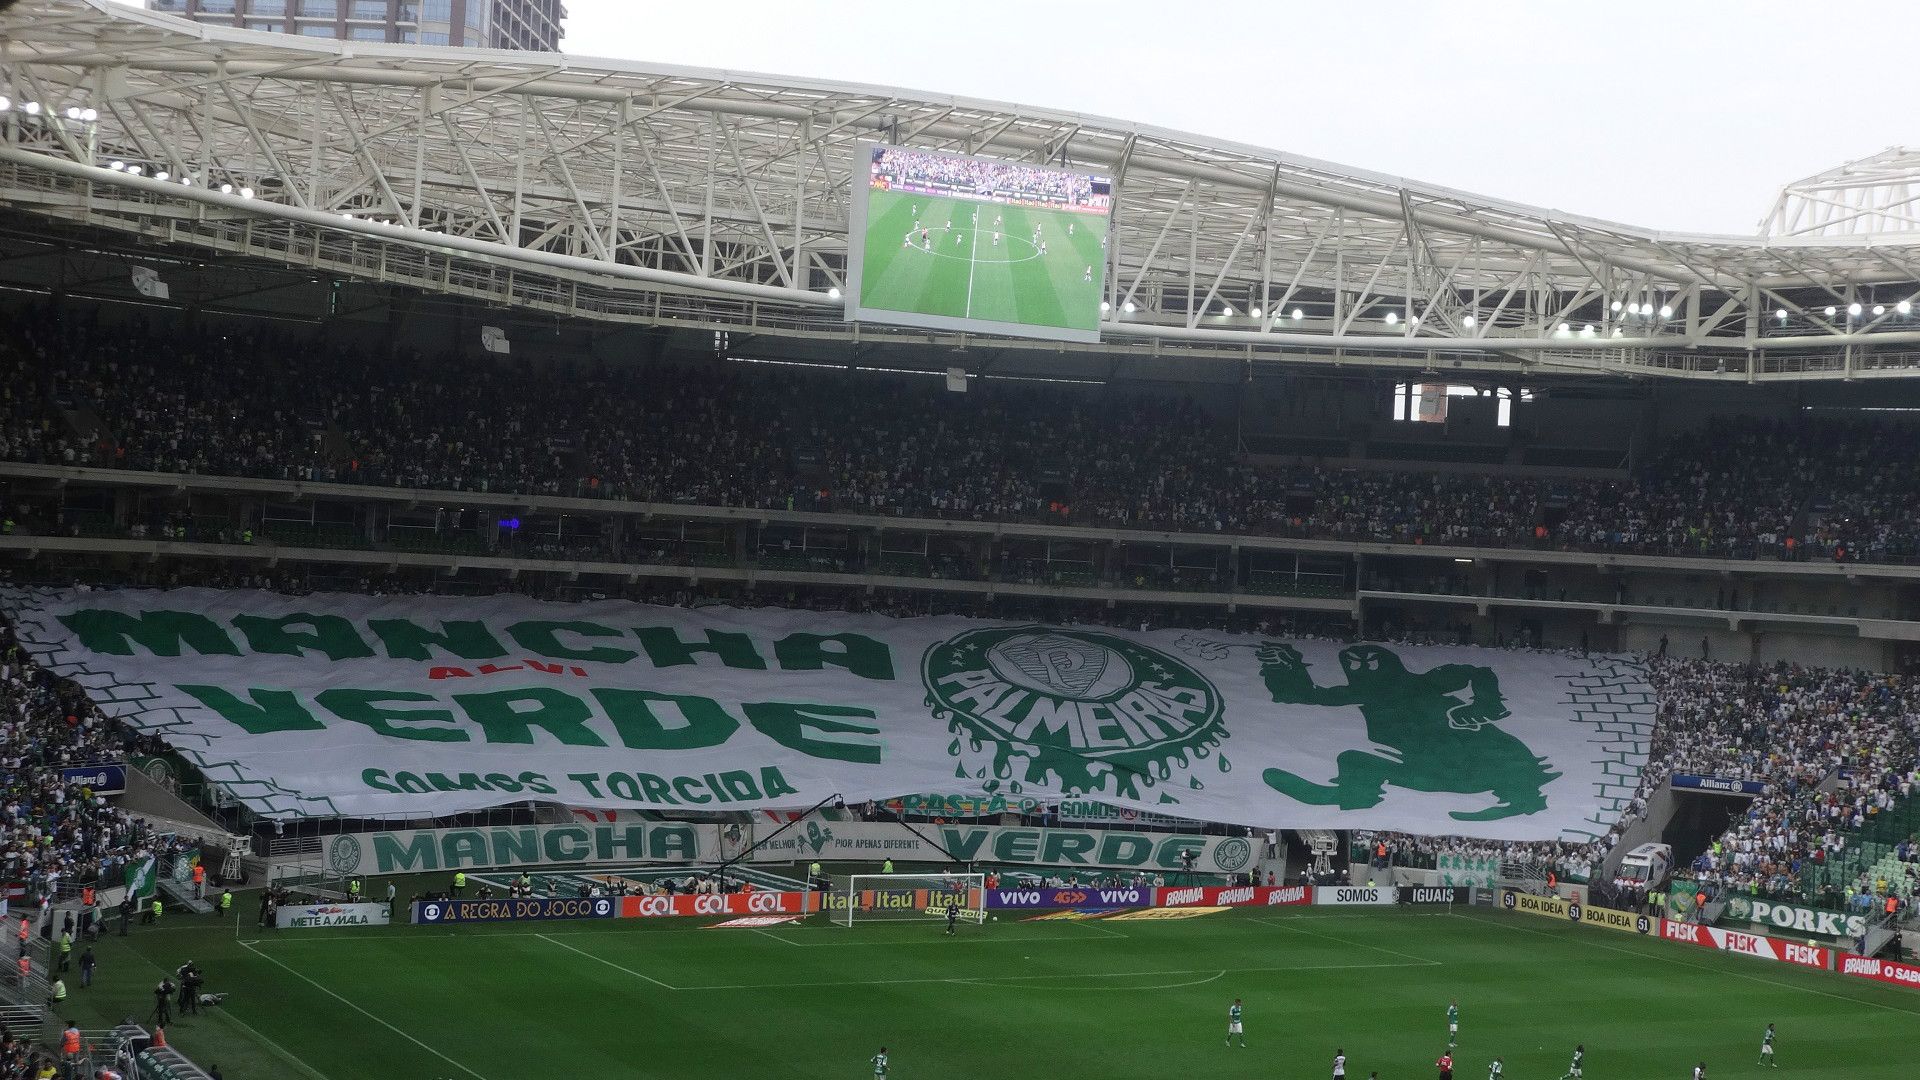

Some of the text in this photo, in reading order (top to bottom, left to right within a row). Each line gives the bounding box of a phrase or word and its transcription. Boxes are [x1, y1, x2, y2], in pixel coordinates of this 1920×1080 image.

[56, 609, 895, 680] MANCHA
[428, 659, 588, 681] ALVI
[937, 669, 1207, 748] PALMEIRAS
[174, 685, 881, 764] VERDE
[361, 766, 800, 805] SOMOS TORCIDA
[1700, 779, 1730, 790] Allianz
[1060, 801, 1119, 818] SOMOS
[373, 823, 700, 873] MANCHA
[770, 840, 795, 850] MELHOR
[835, 838, 920, 850] PIOR APENAS DIFERENTE
[939, 826, 1207, 869] VERDE
[694, 895, 733, 914] GOL
[748, 893, 787, 912] GOL
[822, 891, 859, 910] Itaú
[876, 890, 913, 908] Itaú
[930, 890, 966, 907] Itaú
[1166, 887, 1204, 906] BRAHMA
[1217, 886, 1254, 906] BRAHMA
[1268, 886, 1305, 905] BRAHMA
[1337, 888, 1378, 902] SOMOS
[1412, 888, 1454, 902] IGUAIS
[1505, 894, 1515, 906] 51
[444, 900, 592, 920] A REGRA DO JOGO
[639, 896, 679, 916] GOL
[1521, 897, 1564, 915] BOA IDEIA
[1569, 906, 1580, 919] 51
[290, 914, 369, 927] METE A MALA
[1586, 909, 1631, 927] BOA IDEIA
[1637, 918, 1649, 931] 51
[1751, 901, 1866, 937] PORK'S
[1666, 922, 1699, 942] FISK
[1725, 932, 1759, 953] FISK
[1785, 943, 1821, 966] FISK
[1844, 958, 1920, 983] BRAHMA O SAB
